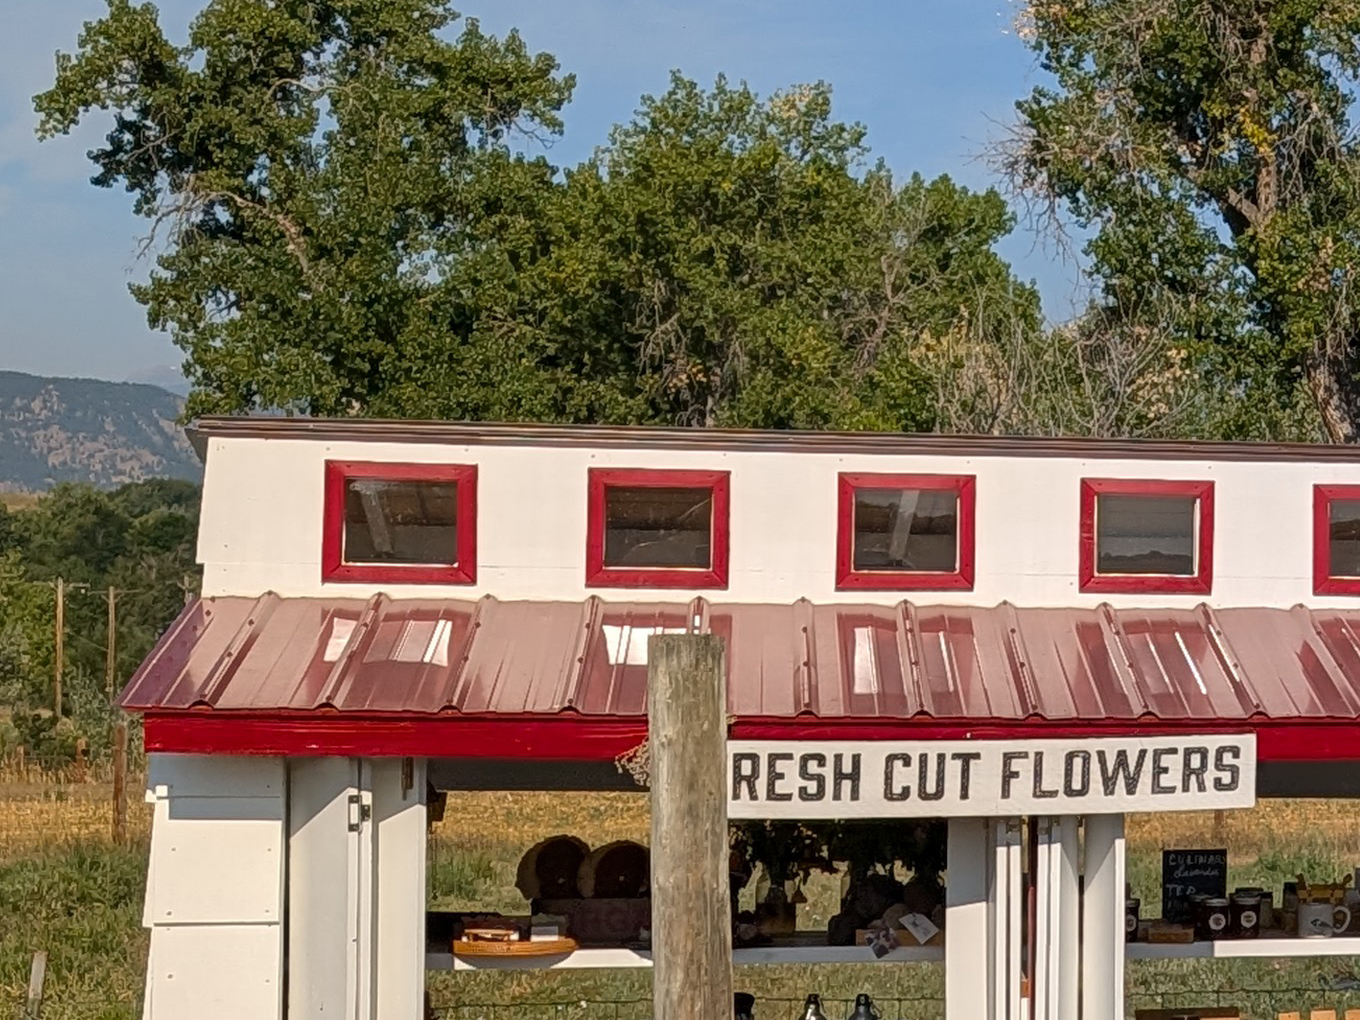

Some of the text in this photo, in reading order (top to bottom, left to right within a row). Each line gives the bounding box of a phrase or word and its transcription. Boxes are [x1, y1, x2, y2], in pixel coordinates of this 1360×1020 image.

[732, 745, 1241, 801] RESH CUT FLOWERS
